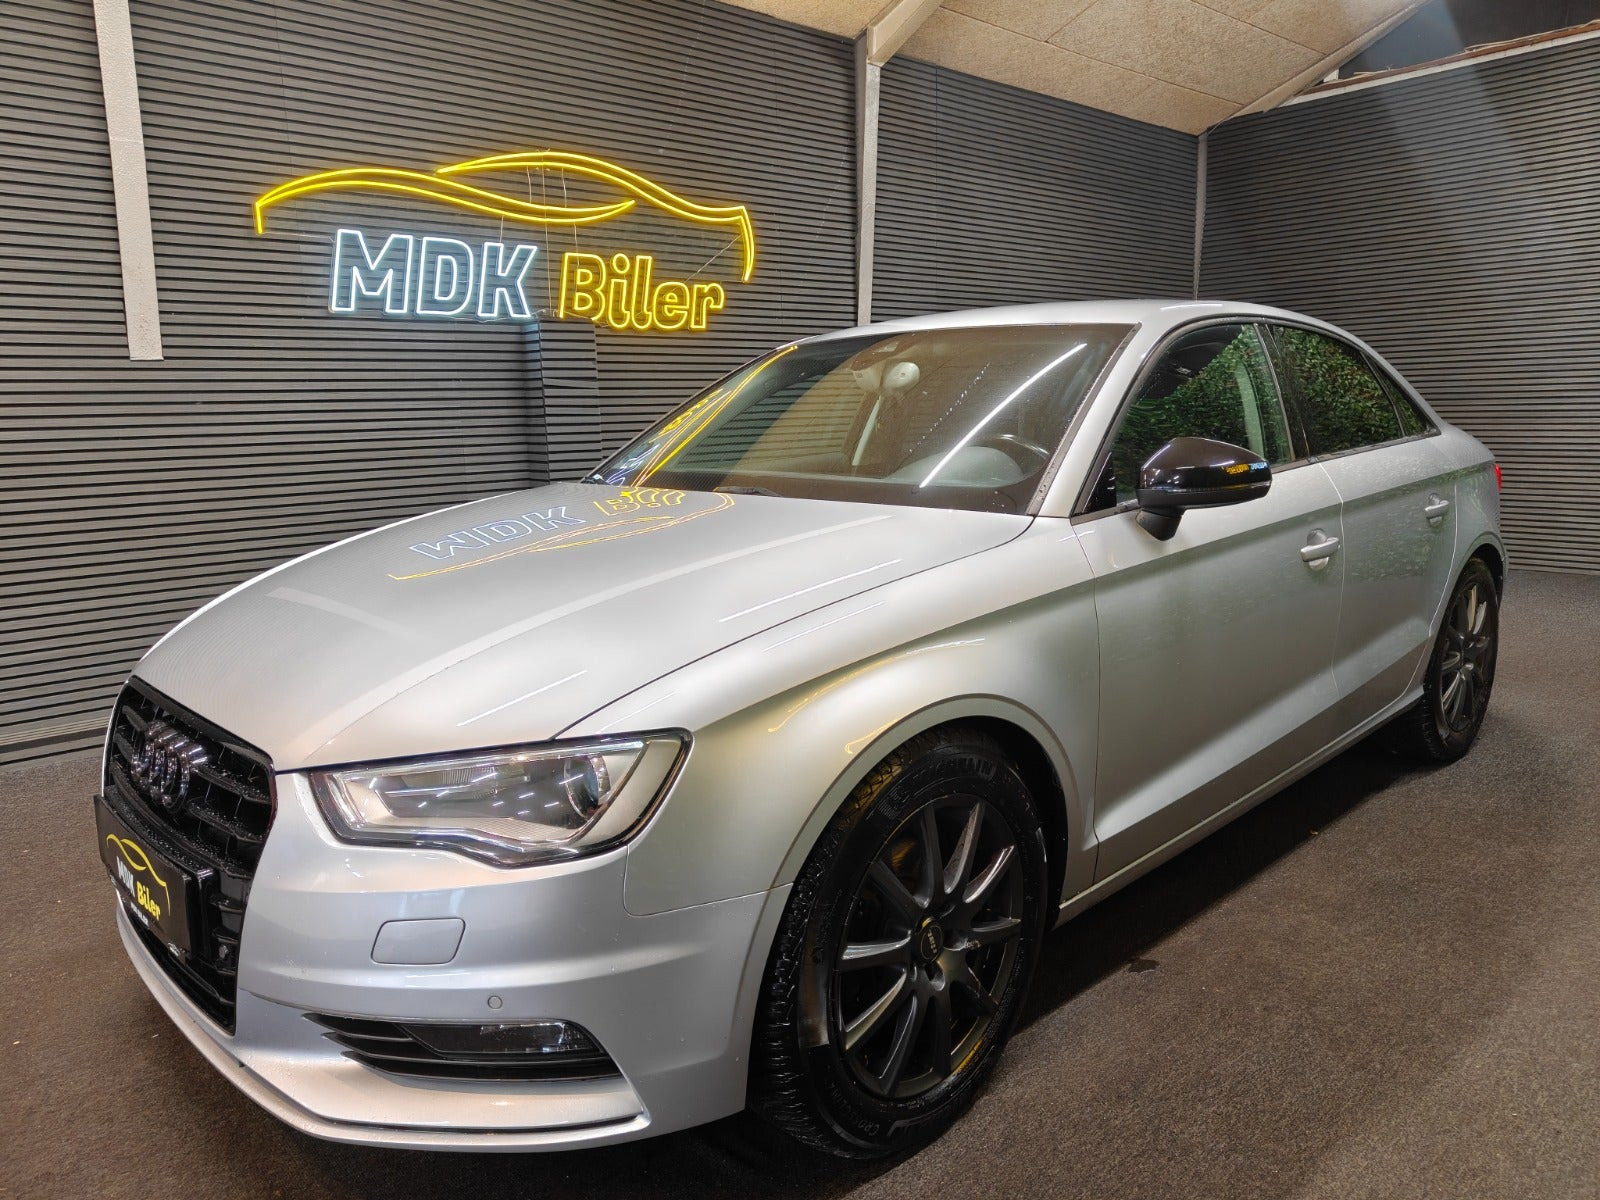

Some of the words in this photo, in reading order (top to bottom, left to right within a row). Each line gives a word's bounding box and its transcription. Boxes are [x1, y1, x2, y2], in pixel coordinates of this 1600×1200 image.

[330, 229, 538, 318] MDK
[558, 252, 725, 331] Biler
[136, 880, 161, 921] Biler
